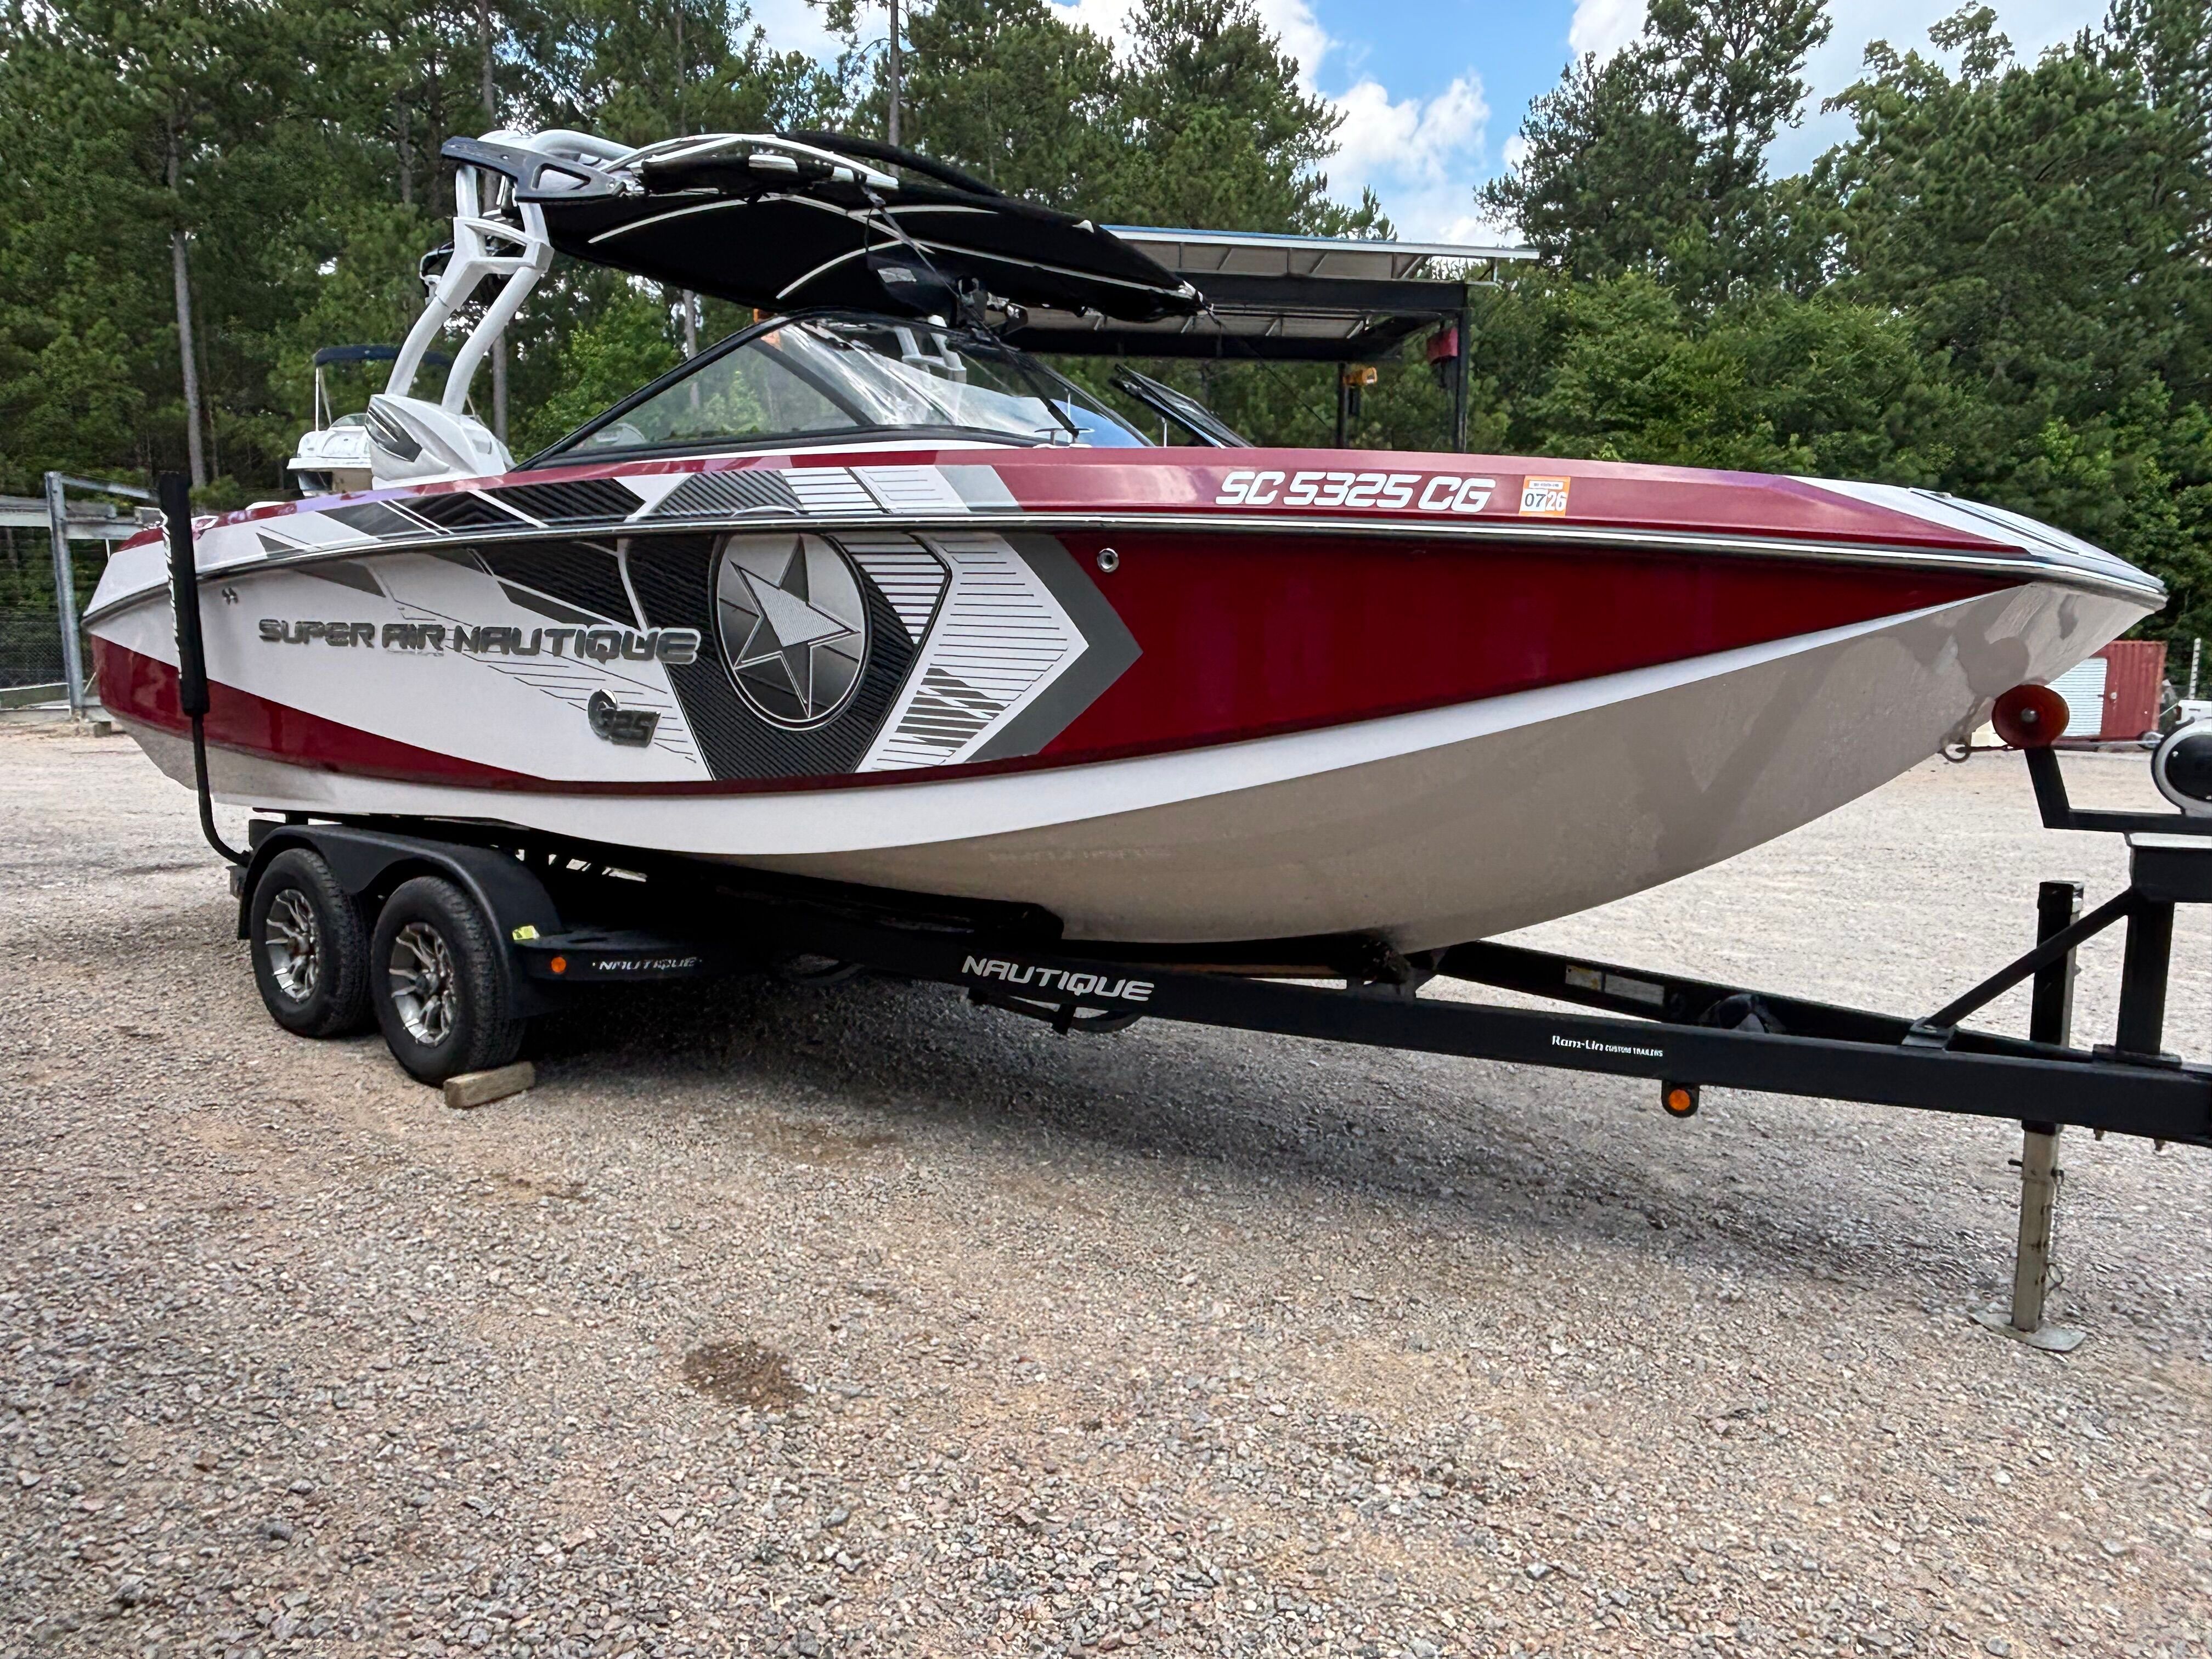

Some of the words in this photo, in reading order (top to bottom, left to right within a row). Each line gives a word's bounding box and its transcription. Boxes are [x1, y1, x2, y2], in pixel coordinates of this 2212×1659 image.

[1215, 471, 1285, 505] SC
[1284, 471, 1423, 509] 5325
[1418, 475, 1496, 514] CG
[1525, 493, 1546, 507] 07
[1545, 491, 1567, 511] 26
[258, 618, 375, 649] SUPER
[382, 623, 446, 652] AIR
[452, 624, 701, 665] NAUTIQUE
[599, 957, 697, 970] NAUTIQUE
[961, 955, 1154, 1002] NAUTIQUE
